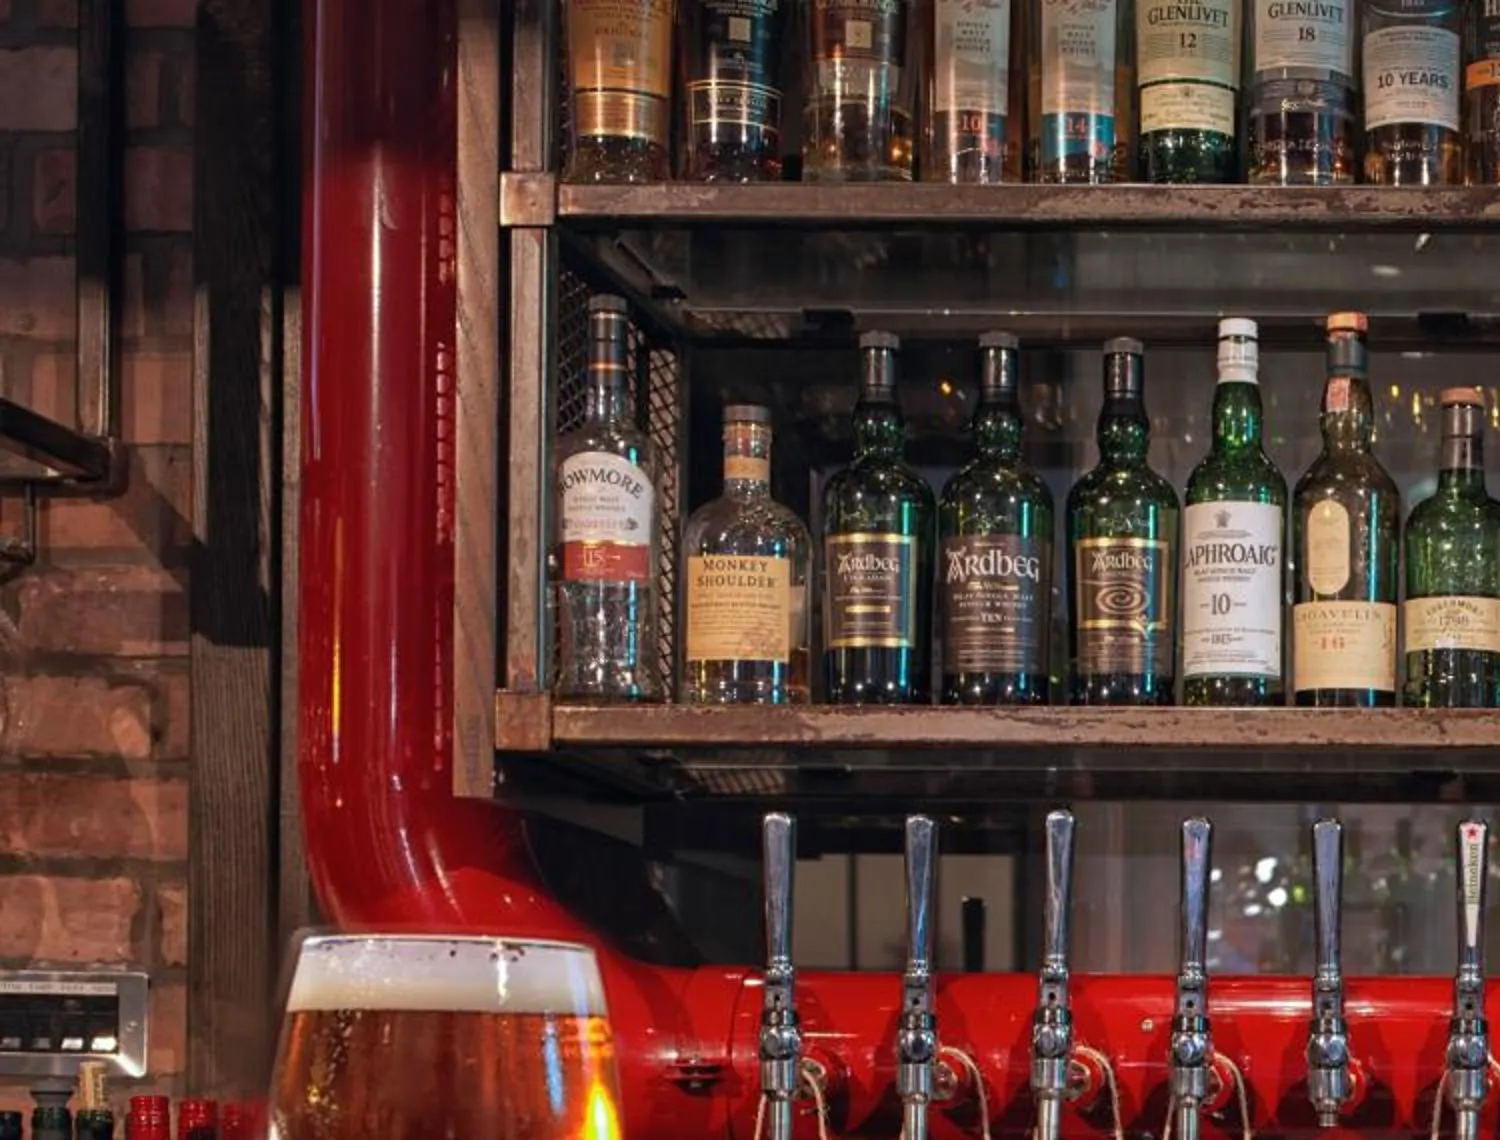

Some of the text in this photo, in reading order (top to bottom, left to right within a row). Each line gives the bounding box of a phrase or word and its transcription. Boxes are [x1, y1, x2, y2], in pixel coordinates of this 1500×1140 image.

[1148, 4, 1228, 28] GLENLIVET
[1268, 2, 1343, 23] GLENLIVET
[1179, 33, 1196, 48] 12
[1298, 27, 1315, 41] 18
[1377, 71, 1448, 89] 10 YEARS
[961, 115, 981, 131] 10
[1065, 118, 1086, 132] 14
[703, 560, 768, 572] MONKEY
[837, 552, 900, 575] Ardbeg
[946, 547, 1039, 583] Ardbeg
[1091, 551, 1153, 573] Ardbeg
[698, 576, 776, 588] SHOULDER
[1211, 594, 1230, 616] 10
[1320, 636, 1345, 650] 16
